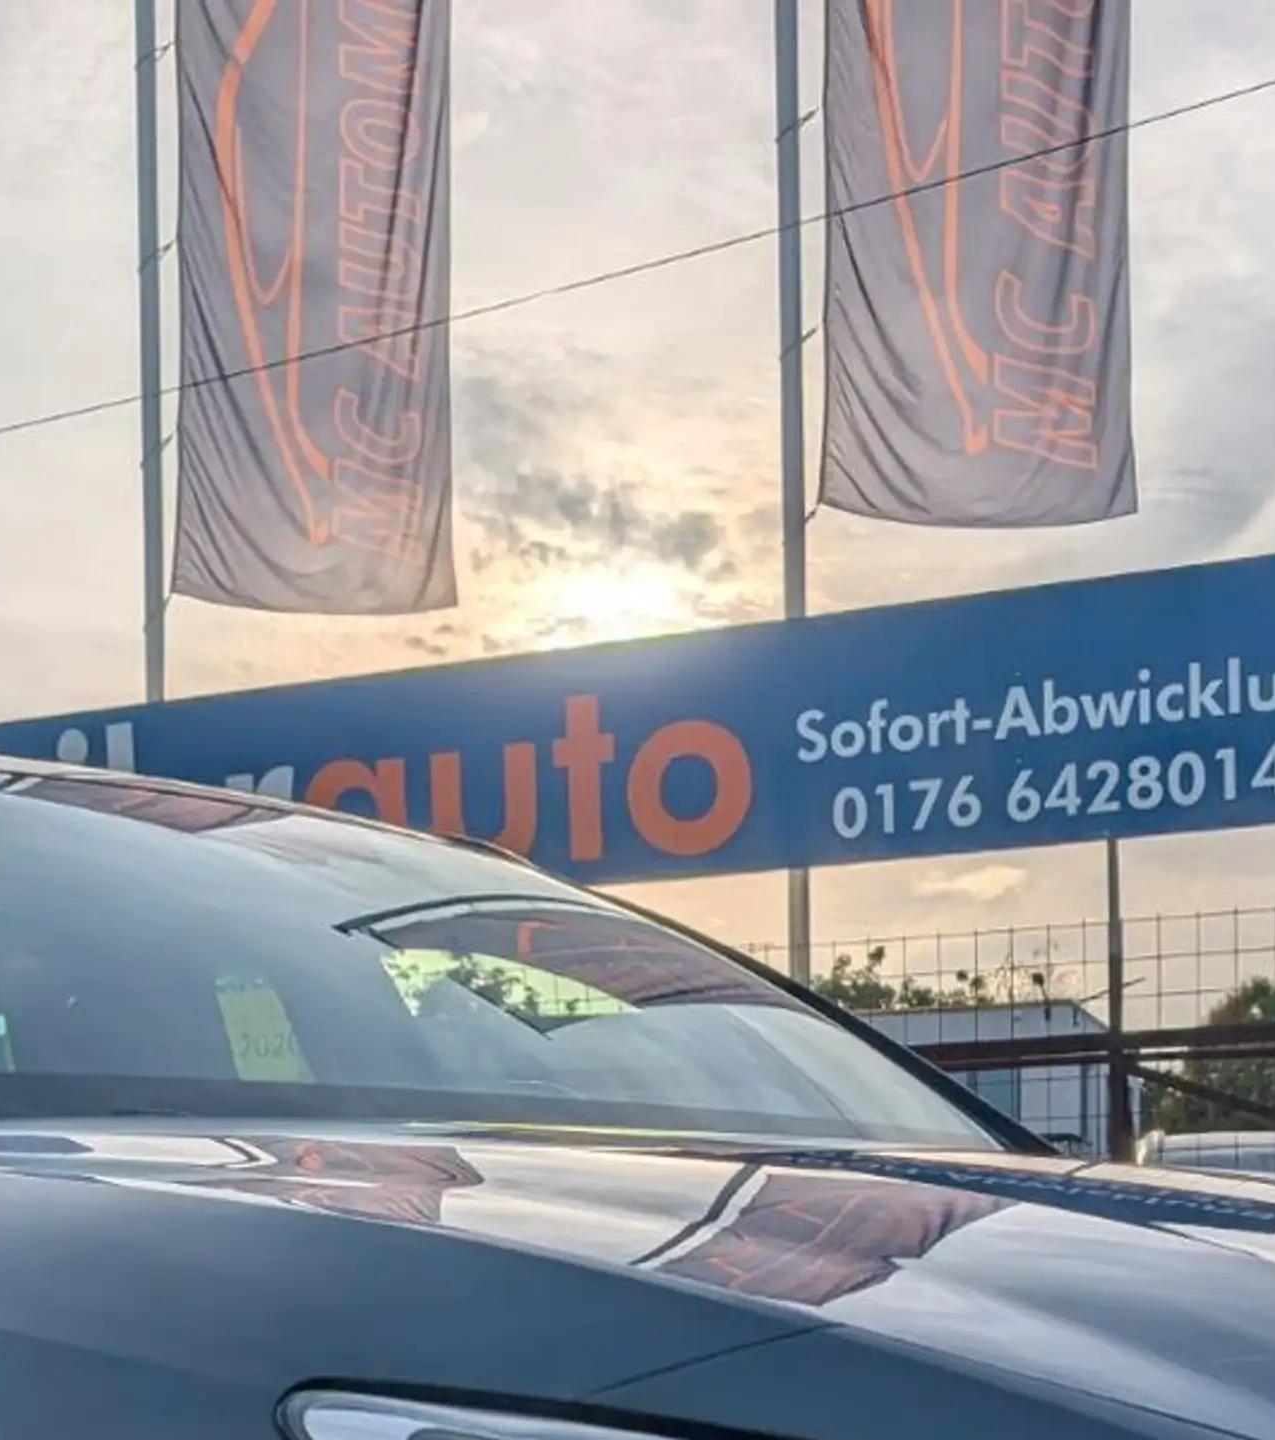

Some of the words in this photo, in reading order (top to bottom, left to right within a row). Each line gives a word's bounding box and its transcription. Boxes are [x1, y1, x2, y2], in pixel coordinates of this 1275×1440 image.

[999, 0, 1096, 259] AUT
[993, 270, 1098, 471] MC
[331, 387, 423, 564] MC
[831, 774, 983, 840] 0176
